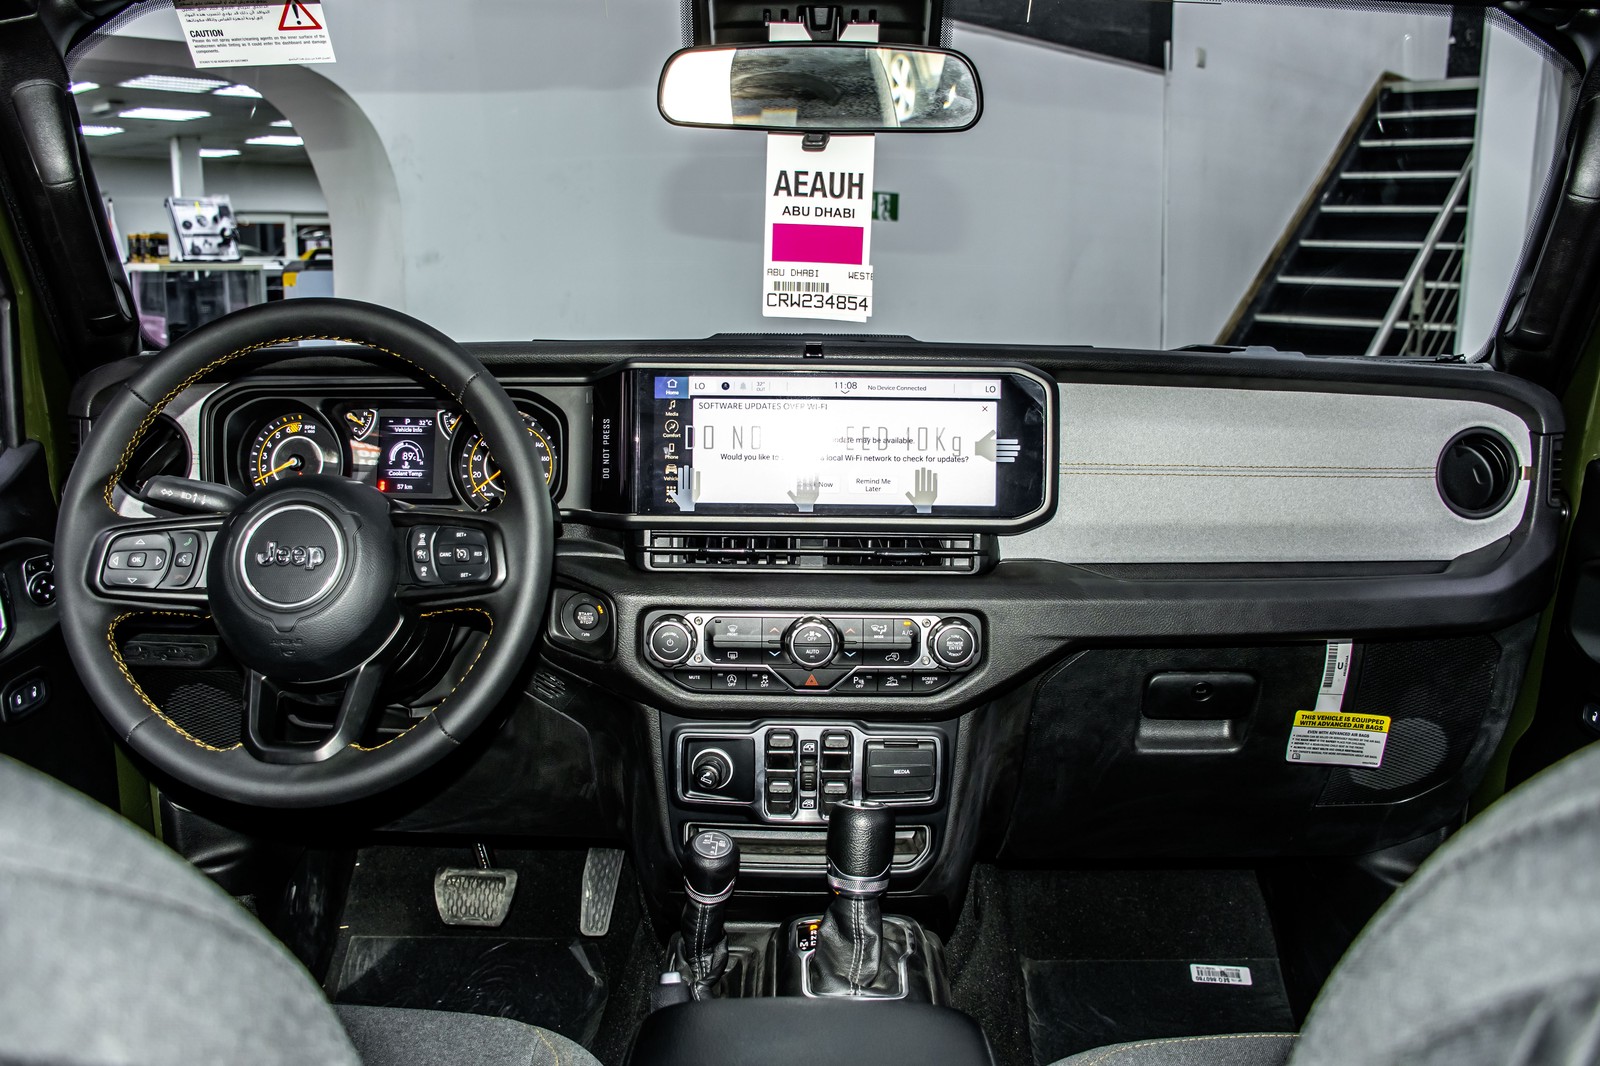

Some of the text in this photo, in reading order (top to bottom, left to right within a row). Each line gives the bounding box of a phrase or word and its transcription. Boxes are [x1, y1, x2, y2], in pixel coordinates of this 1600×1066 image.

[190, 29, 224, 37] CAUTION
[773, 170, 864, 200] AEAUH
[782, 205, 856, 219] ABU DHABI
[767, 268, 820, 278] ABU DHABI
[766, 292, 868, 312] CRW234854
[694, 382, 706, 390] LO
[835, 381, 858, 390] 11:08
[698, 402, 743, 410] SOFTWARE
[744, 402, 781, 410] UPDATES
[685, 425, 714, 450] DO
[602, 418, 610, 479] DO NOT PRESS
[720, 453, 743, 461] Would
[758, 453, 771, 461] like
[937, 456, 969, 464] updates?
[257, 541, 326, 570] Jeep
[1352, 717, 1385, 725] EQUIPPED
